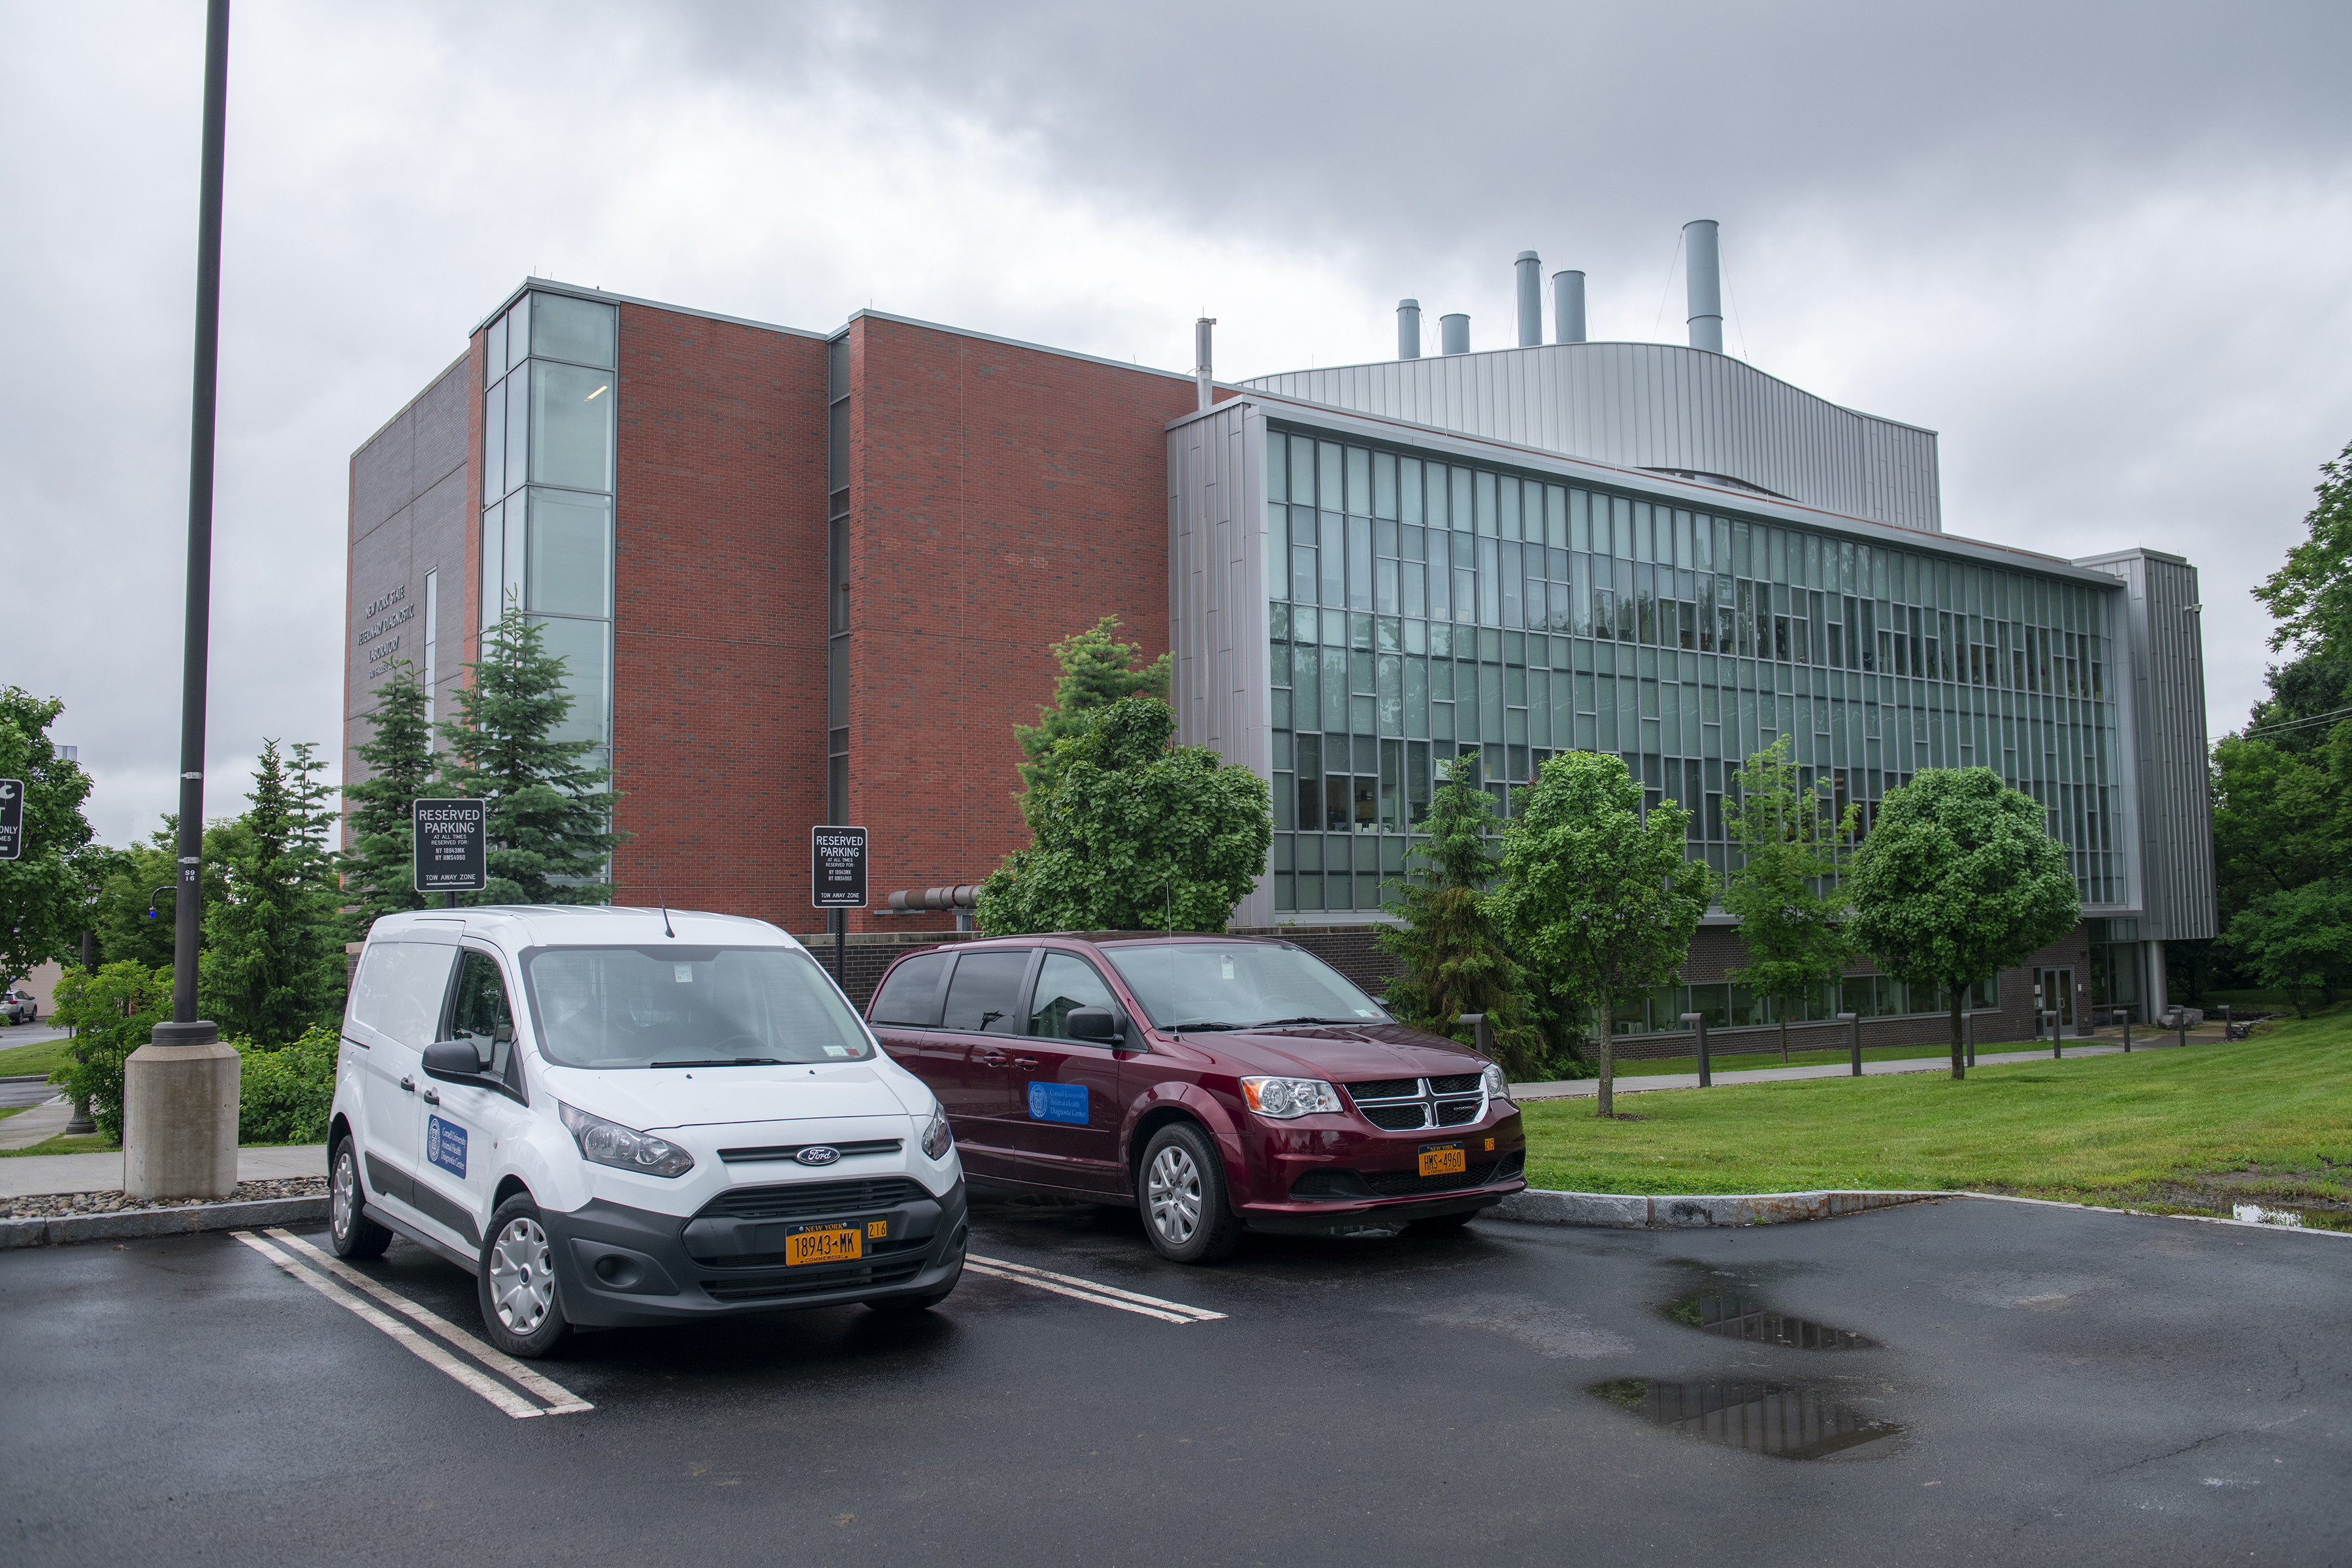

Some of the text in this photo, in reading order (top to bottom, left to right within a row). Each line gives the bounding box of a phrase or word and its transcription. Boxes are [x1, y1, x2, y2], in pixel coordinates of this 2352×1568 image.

[366, 585, 404, 619] NEW YORK STATE
[357, 603, 414, 645] VETERINARY DIAGNOSTIC
[369, 636, 399, 663] LABORATORY
[419, 810, 480, 820] RESERVED
[0, 826, 18, 834] ONLY
[425, 822, 475, 833] PARKING
[816, 836, 863, 846] RESERVED
[821, 847, 859, 857] PARKING
[1065, 1091, 1086, 1101] University
[1050, 1107, 1071, 1117] Diagnostic
[442, 1127, 466, 1149] Cornell University
[442, 1140, 461, 1156] Animal Health
[1485, 1139, 1494, 1150] 215
[808, 1149, 831, 1160] Ford
[441, 1151, 464, 1170] Diagnostic Center
[805, 1224, 823, 1233] NEW
[869, 1223, 886, 1237] 216
[805, 1254, 844, 1262] COMMERCIAL
